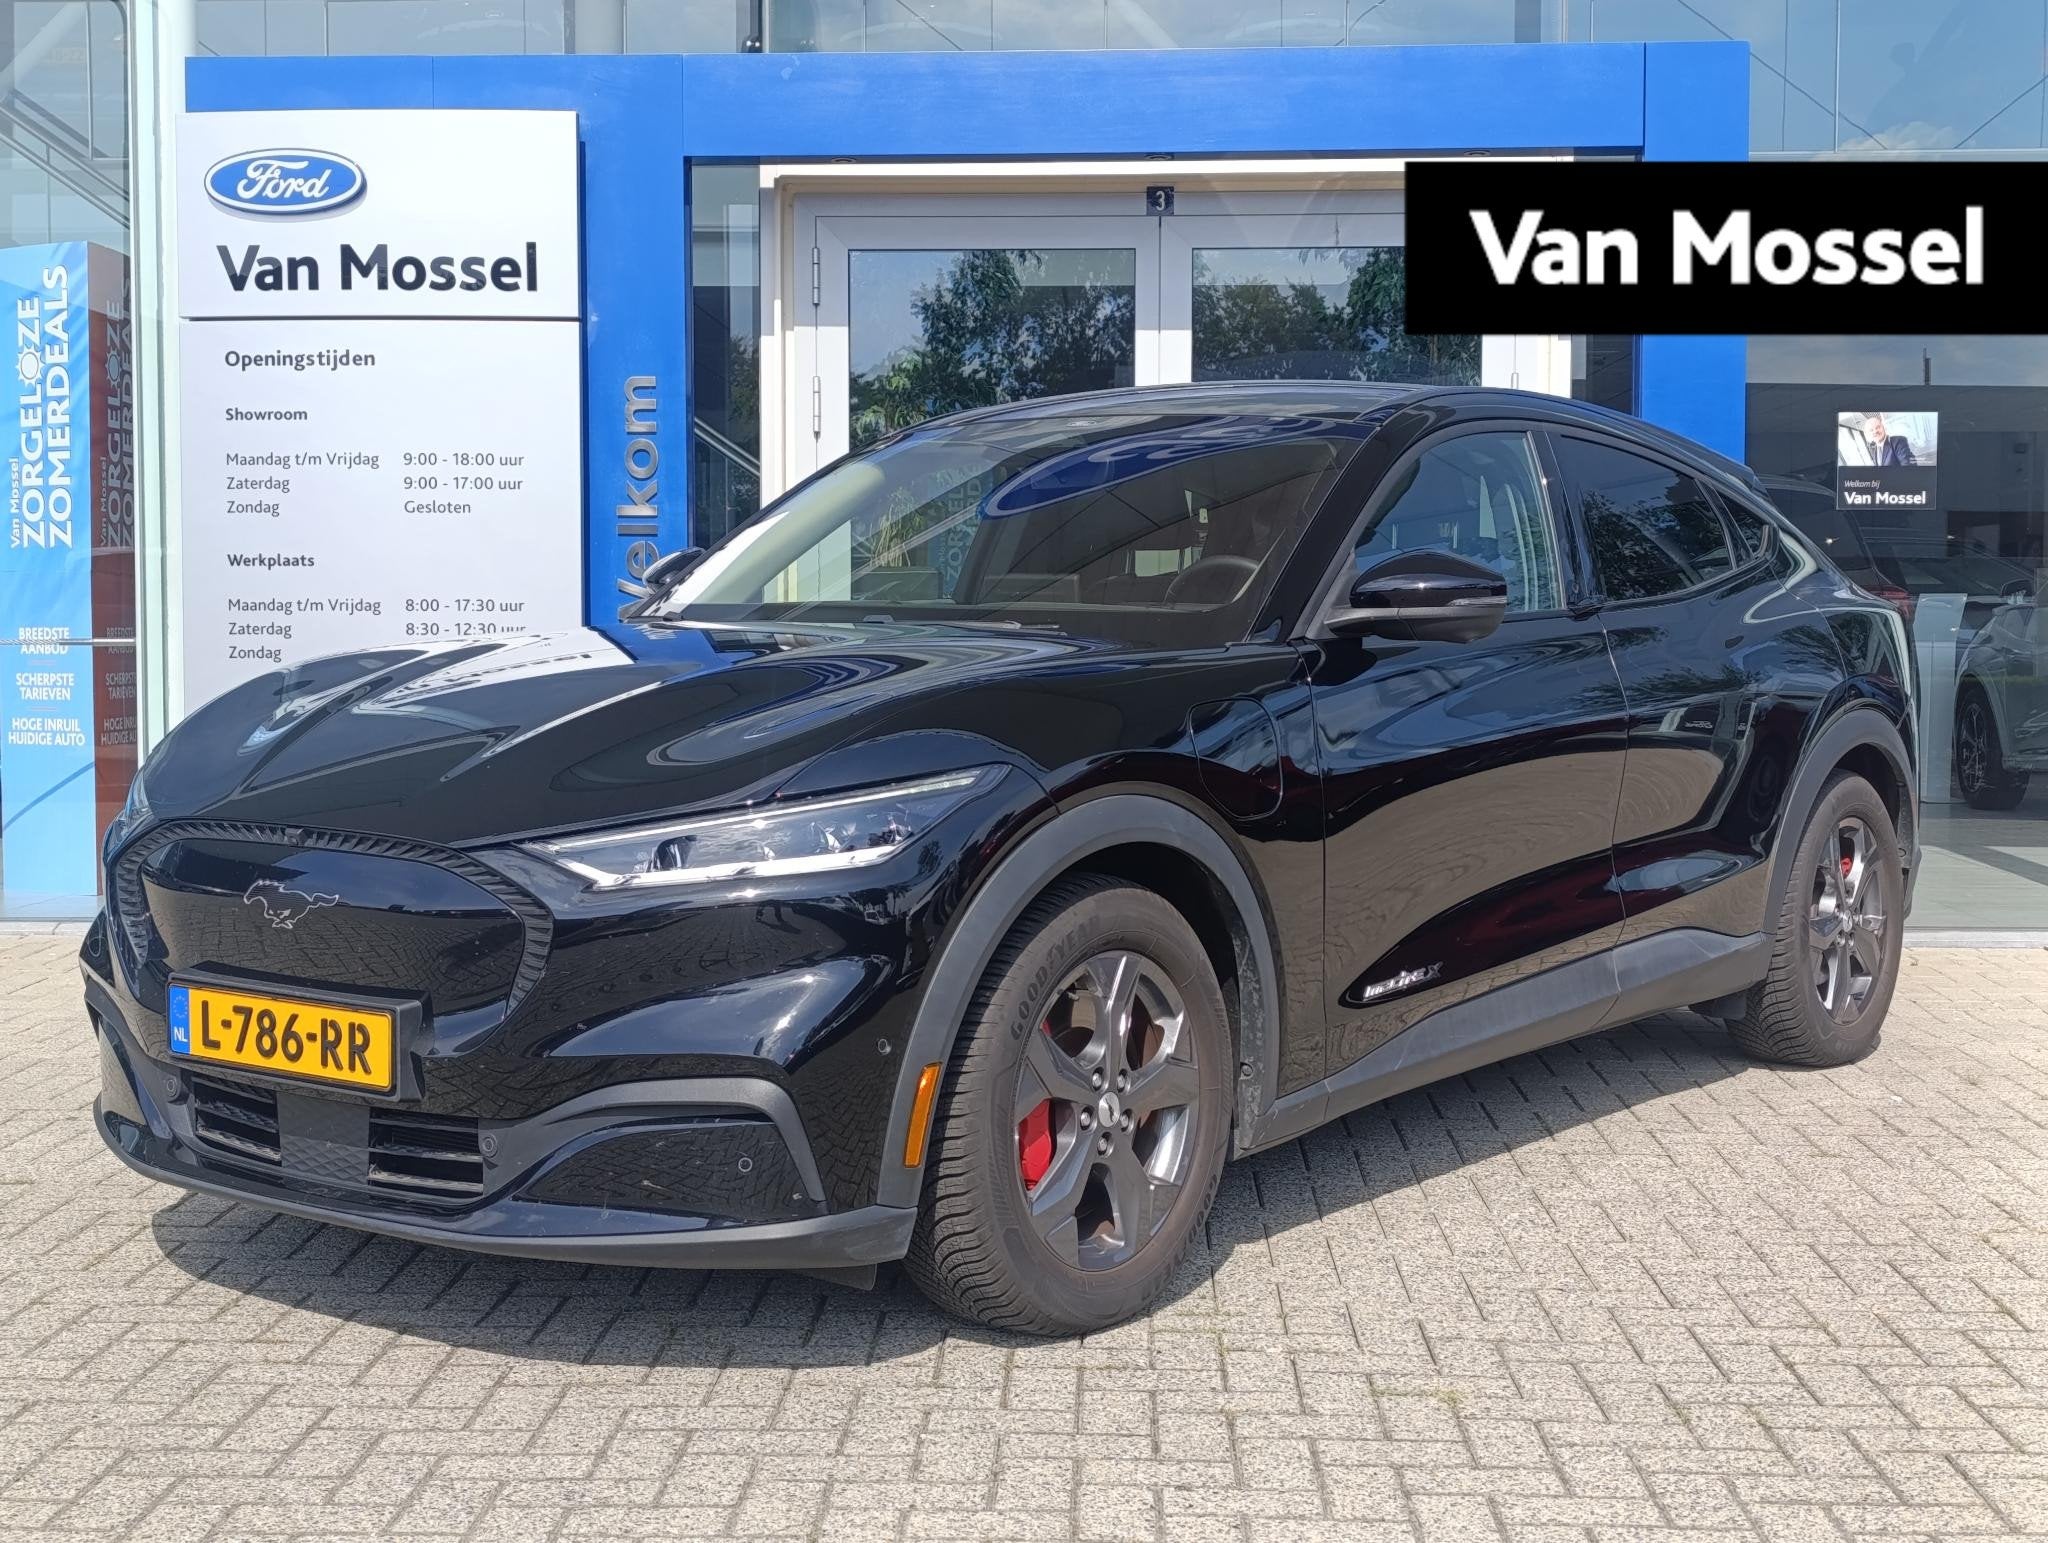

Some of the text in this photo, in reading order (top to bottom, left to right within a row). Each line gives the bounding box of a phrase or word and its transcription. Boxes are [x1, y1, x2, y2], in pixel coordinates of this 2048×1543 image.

[236, 158, 333, 200] Ford
[1155, 190, 1166, 211] 3
[216, 241, 538, 292] Van Mossel
[225, 349, 376, 372] Openingstijden
[43, 265, 73, 549] ZOMERDEALS
[225, 407, 308, 421] Showroom
[226, 452, 291, 470] Maandag
[294, 451, 322, 466] t/m
[326, 451, 380, 470] Vrijdag
[403, 452, 438, 466] 9:00
[453, 452, 495, 466] 18:00
[499, 456, 525, 466] uur
[226, 476, 291, 494] Zaterdag
[403, 476, 438, 490] 9:00
[453, 476, 494, 490] 17:00
[498, 480, 524, 490] uur
[8, 456, 20, 549] Van Mossel
[1843, 491, 1927, 505] Van Mossel
[226, 499, 471, 518] Zondag Gesloten
[226, 553, 315, 571] Werkplaats
[228, 598, 293, 616] Maandag
[296, 598, 324, 612] t/m
[327, 598, 382, 616] Vrijdag
[405, 598, 440, 612] 8:00
[454, 598, 495, 612] 17:30
[499, 602, 525, 612] uur
[19, 627, 70, 640] BREEDSTE
[228, 622, 293, 640] Zaterdag
[405, 622, 440, 636] 8:30
[454, 622, 497, 636] 12:30
[228, 646, 282, 664] Zondag
[15, 672, 75, 686] SCHERPSTE
[19, 686, 71, 701] TARIEVEN
[12, 717, 81, 732] HOGE INRUIL
[8, 731, 86, 747] HUIDIGE AUTO
[173, 1026, 189, 1043] NL
[200, 999, 372, 1076] L-786-RR
